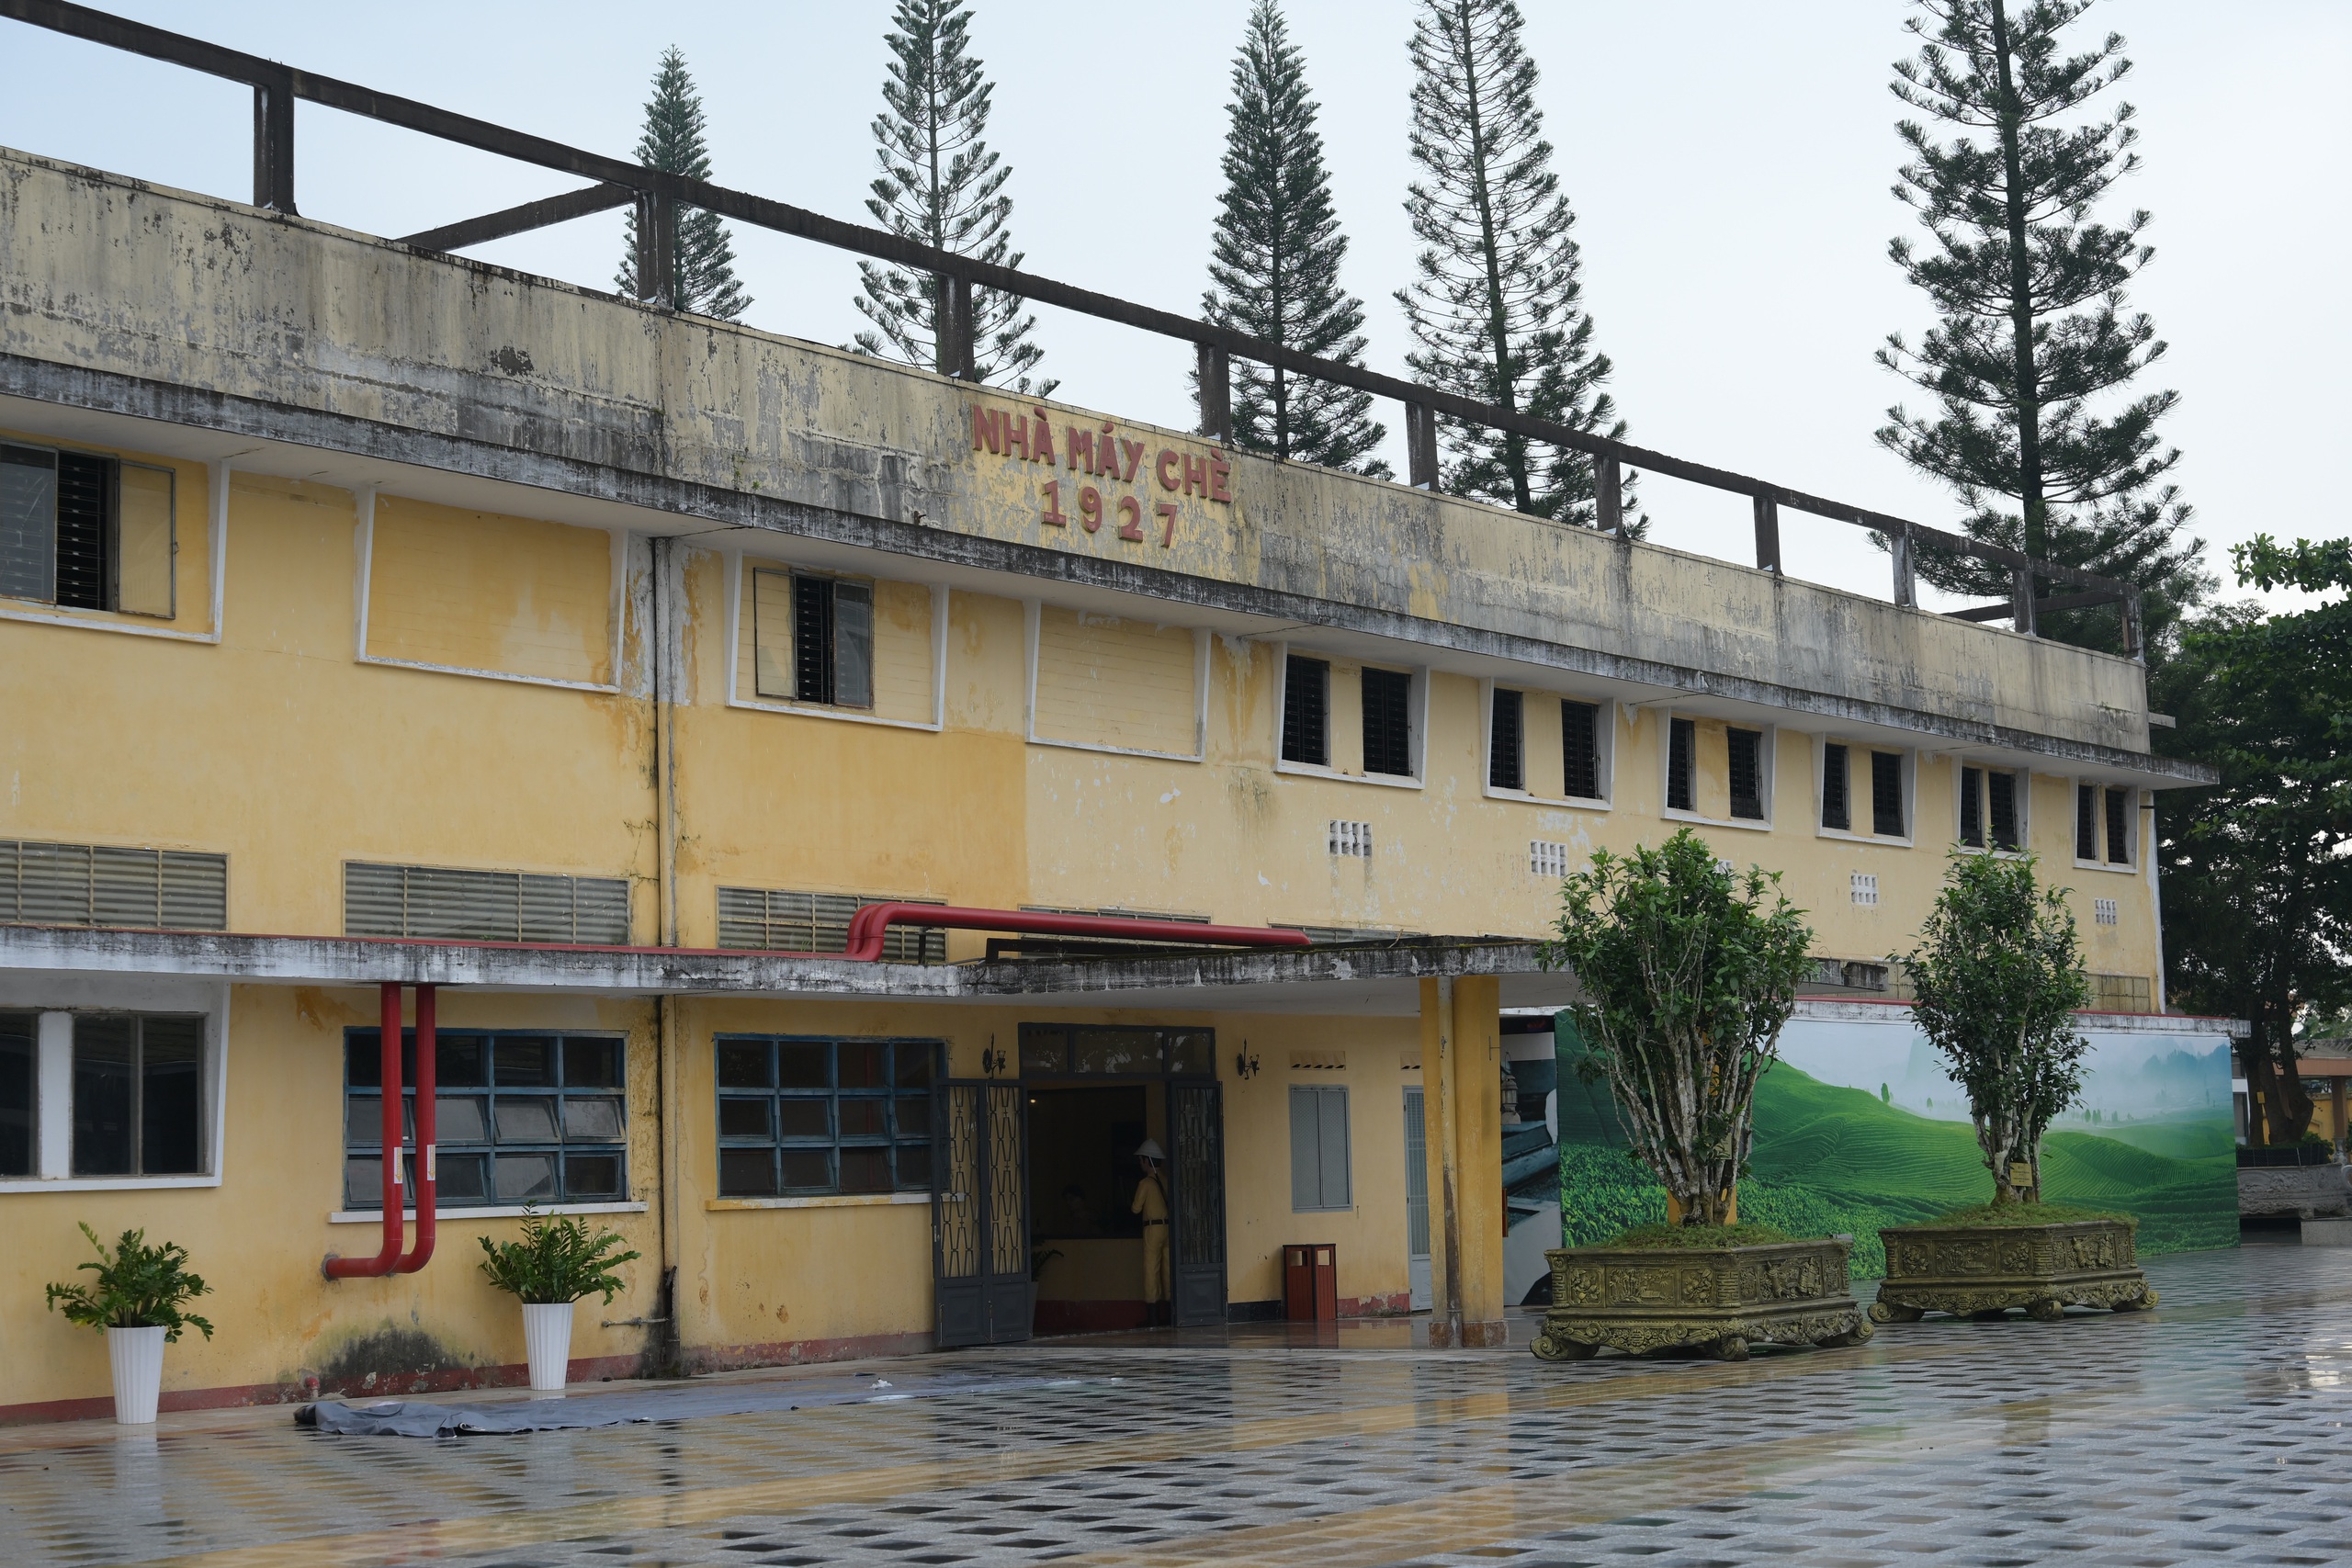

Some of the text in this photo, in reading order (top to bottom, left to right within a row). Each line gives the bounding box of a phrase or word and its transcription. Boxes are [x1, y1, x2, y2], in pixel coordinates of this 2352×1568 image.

[973, 406, 1231, 503] NHÀ MÁY CHÈ
[1041, 480, 1178, 548] 1927
